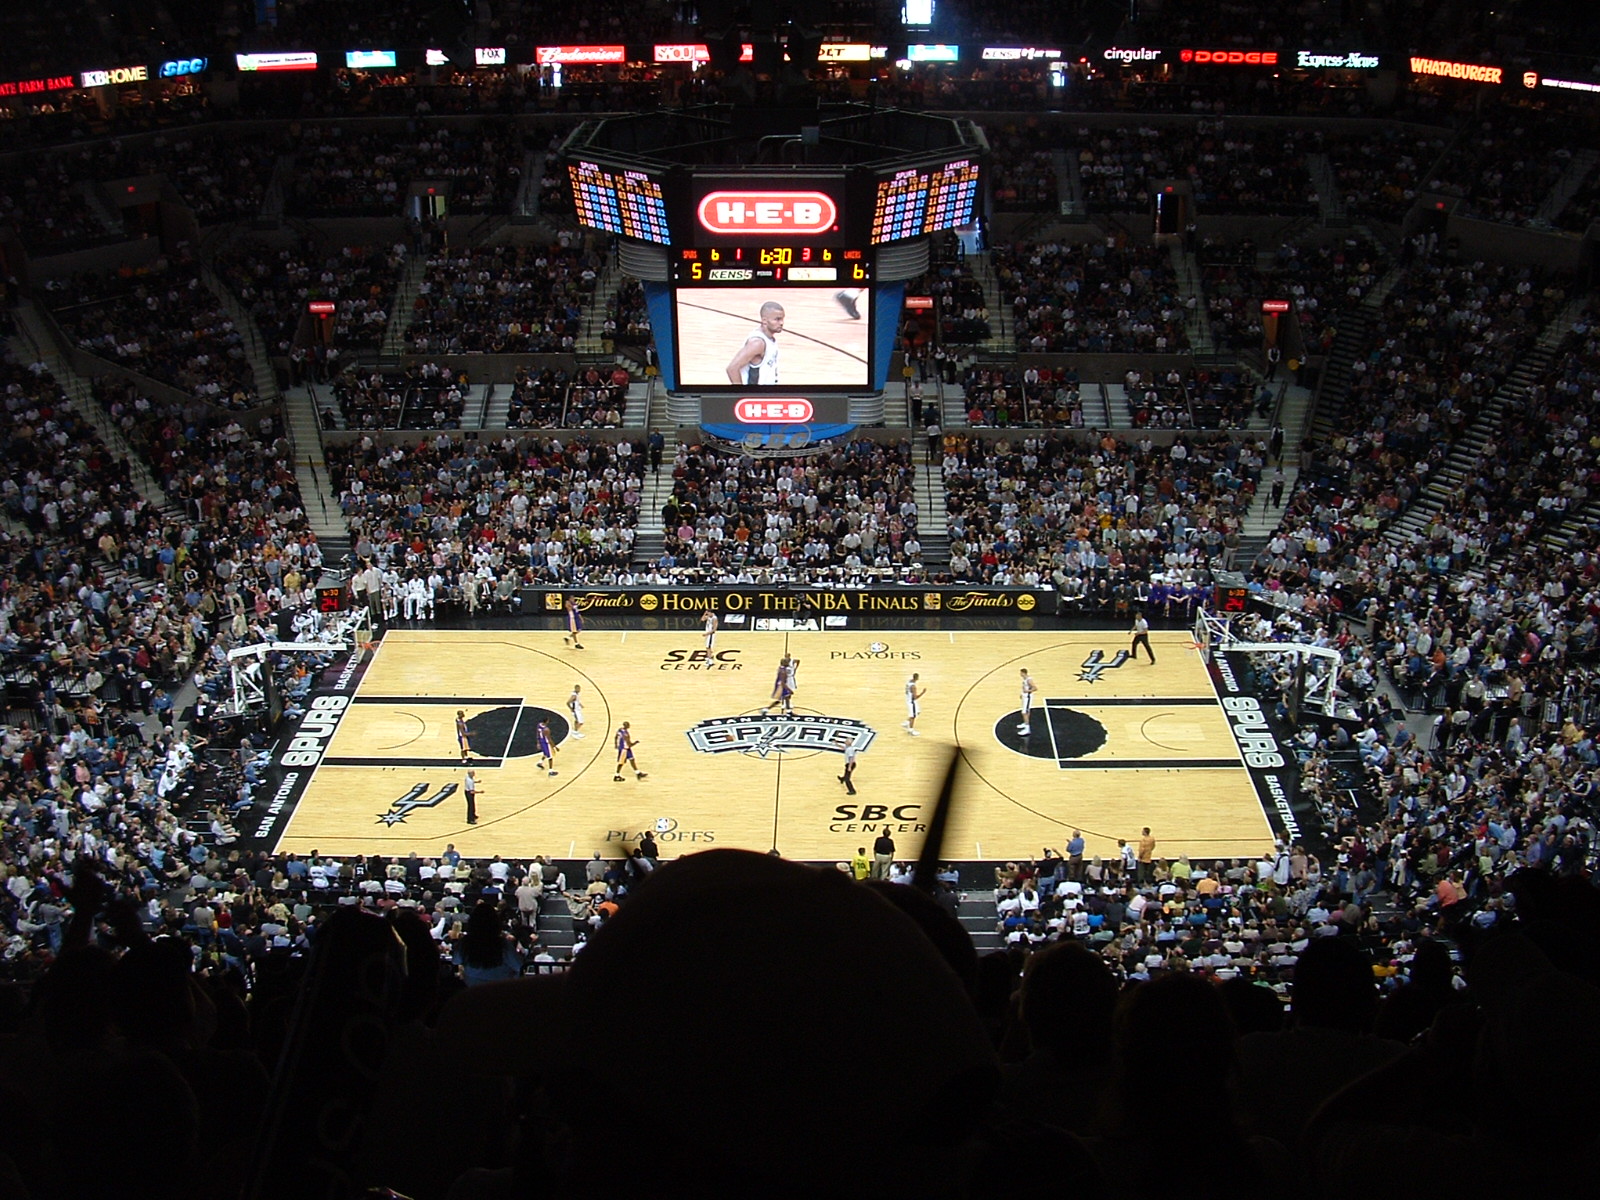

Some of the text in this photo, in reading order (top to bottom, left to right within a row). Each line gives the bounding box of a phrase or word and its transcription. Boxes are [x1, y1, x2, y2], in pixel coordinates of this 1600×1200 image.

[538, 47, 622, 63] Budweiser
[1104, 47, 1161, 62] cingular
[1195, 51, 1278, 64] DODGE
[1297, 51, 1379, 67] Express-News
[163, 59, 203, 77] SBC
[1410, 57, 1502, 83] WHATABURGER
[19, 80, 45, 94] FARM
[49, 76, 75, 90] BANK
[580, 162, 598, 171] SPURS
[945, 160, 969, 170] LAKERS
[624, 170, 648, 181] LAKERS
[896, 170, 916, 180] SPURS
[717, 202, 822, 224] H-E-B
[711, 249, 720, 261] 6
[736, 248, 741, 259] 1
[760, 248, 792, 264] 6:30
[802, 248, 811, 260] 3
[823, 249, 832, 261] 6
[692, 263, 702, 279] 5
[776, 268, 781, 279] 1
[853, 263, 864, 279] 6
[744, 404, 805, 418] H-E-B
[321, 598, 338, 611] 24
[580, 592, 634, 610] Finals
[806, 593, 851, 610] NBA
[959, 592, 1013, 610] Finals
[1225, 598, 1244, 610] 24
[664, 650, 741, 662] SBC
[830, 651, 921, 660] PLAYOFFS
[712, 716, 853, 726] SAN ANTONIO
[281, 696, 349, 767] SPURS
[705, 726, 858, 747] SPURS
[1222, 696, 1286, 769] SPURS
[255, 773, 298, 838] SAN ANTONIO
[832, 804, 922, 821] SBC
[1264, 775, 1302, 841] BASKETBALL
[829, 823, 926, 833] CENTER
